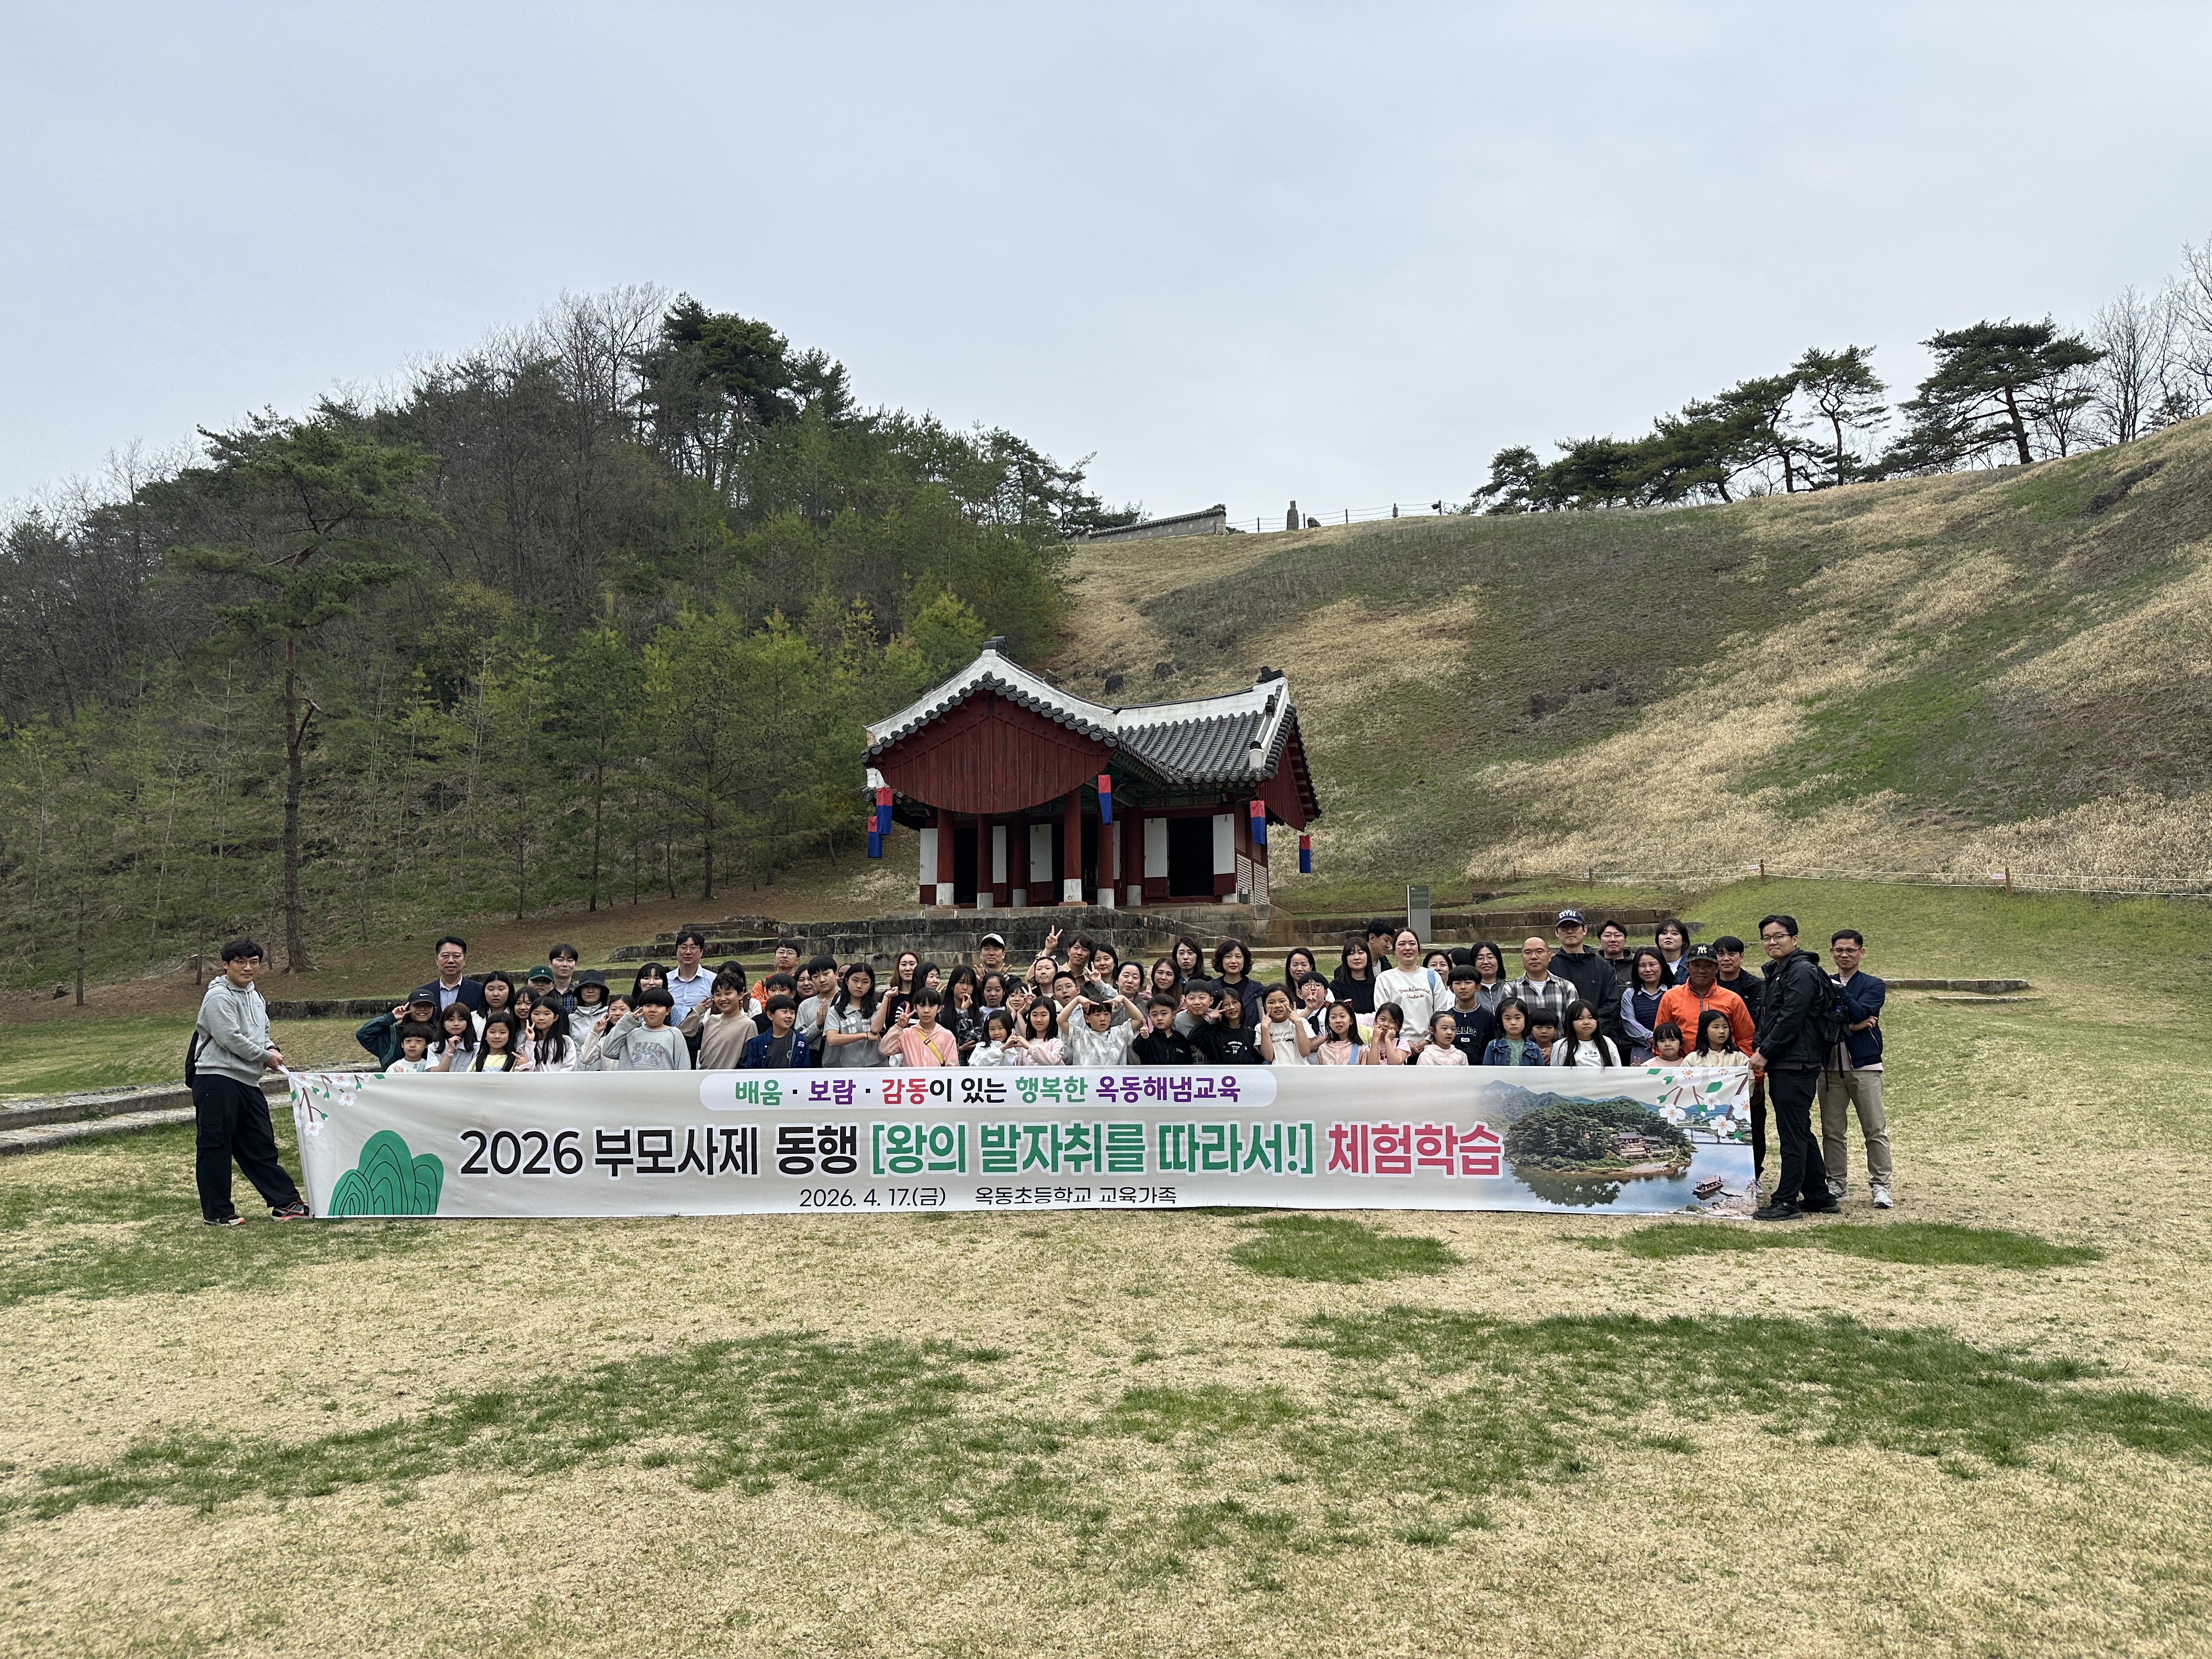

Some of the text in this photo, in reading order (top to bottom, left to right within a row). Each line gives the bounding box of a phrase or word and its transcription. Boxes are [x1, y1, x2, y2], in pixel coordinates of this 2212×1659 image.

[736, 1080, 782, 1105] 배움
[809, 1080, 856, 1104] 보람
[883, 1079, 951, 1104] 감동이
[961, 1078, 1007, 1103] 있는
[1015, 1076, 1087, 1103] 행복한
[1096, 1076, 1240, 1103] 옥동해냄교육
[461, 1124, 1499, 1176] 2026 부모사제 동행 [왕의 발자취를 따라서!] 체험학습
[800, 1187, 1176, 1206] 2026. 4. 17.(금) 옥동초등학교 교육가족
